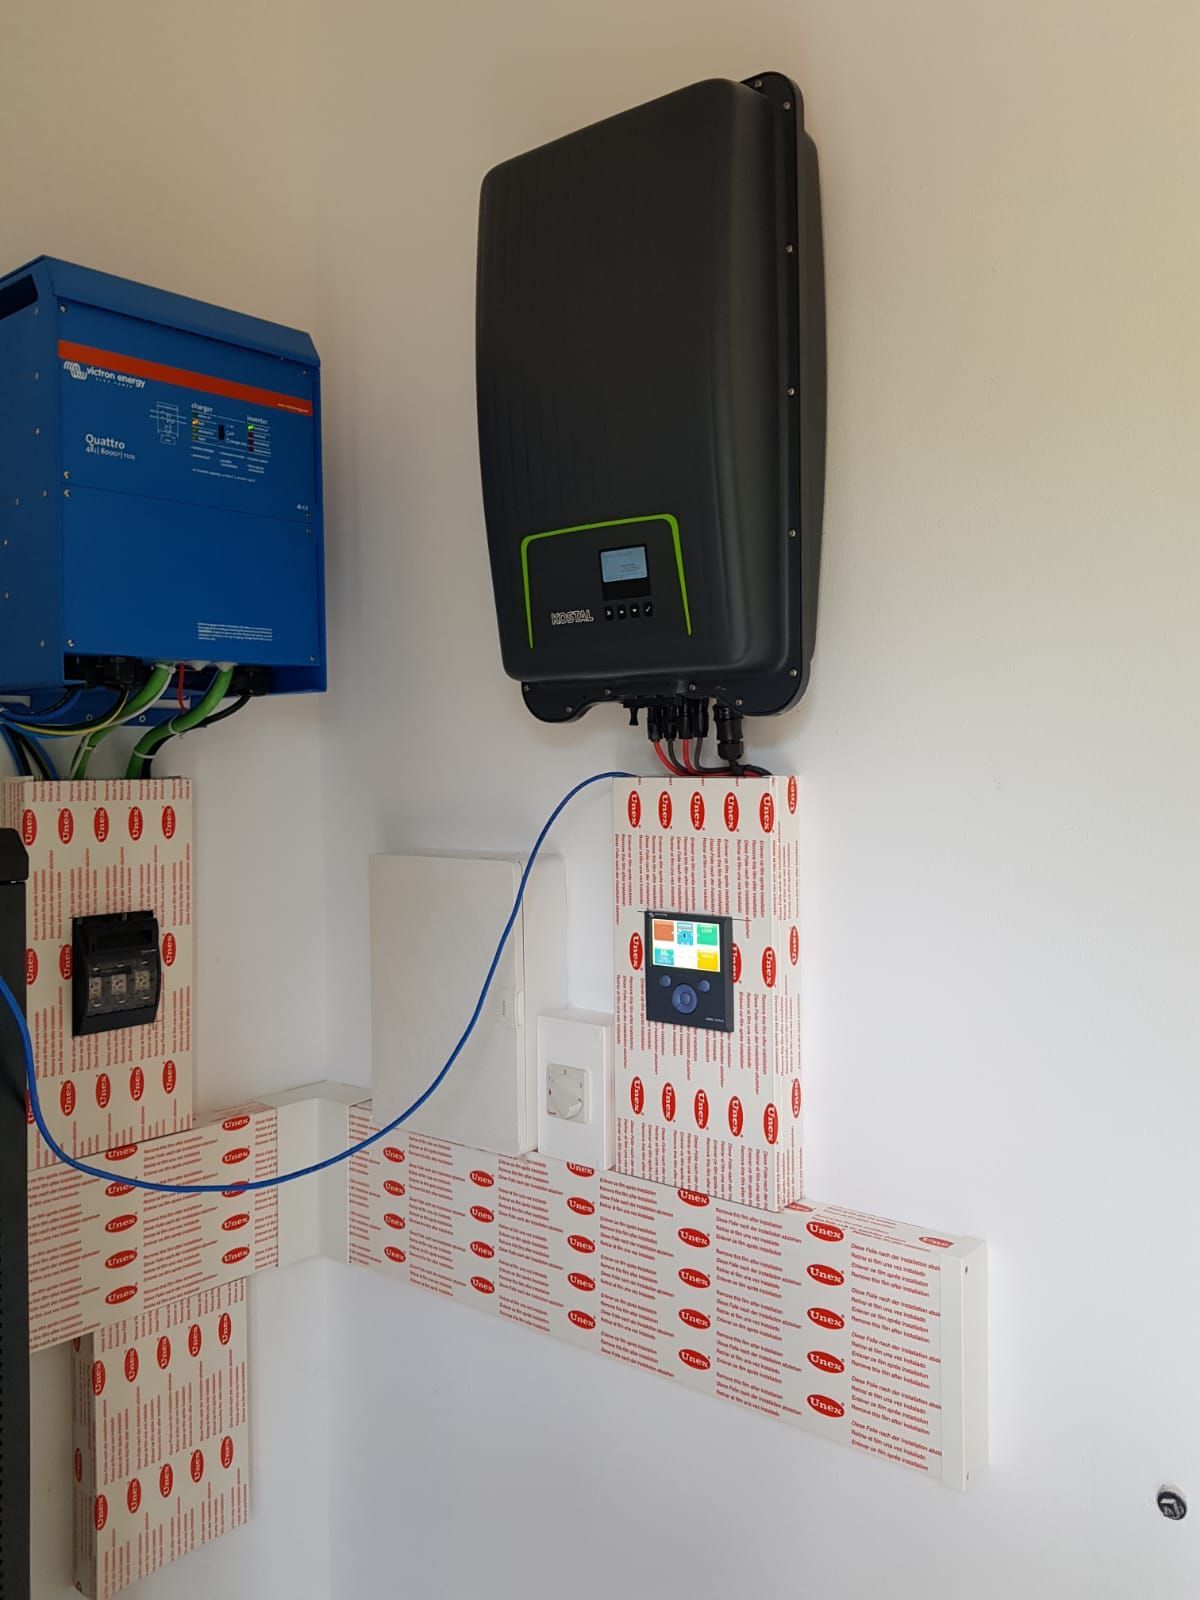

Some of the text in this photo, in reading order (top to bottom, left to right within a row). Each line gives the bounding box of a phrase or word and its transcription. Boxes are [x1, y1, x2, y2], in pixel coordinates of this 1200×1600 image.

[87, 366, 115, 380] victron
[117, 374, 146, 389] energy
[86, 433, 125, 449] Quattro
[551, 609, 594, 626] KOSTAL
[661, 794, 669, 827] Unex
[693, 794, 701, 829] Unex
[727, 795, 736, 830] Unex
[762, 796, 771, 831] Unex
[25, 811, 33, 843] Unex
[62, 810, 70, 842] Unex
[132, 808, 140, 840] Unex
[632, 935, 640, 969] Unex
[765, 950, 773, 986] Unex
[64, 1082, 72, 1114] Unex
[100, 1074, 108, 1106] Unex
[633, 1079, 641, 1113] Unex
[665, 1086, 673, 1119] Unex
[697, 1092, 705, 1127] Unex
[224, 1117, 249, 1129] Unex
[731, 1099, 740, 1134] Unex
[766, 1107, 775, 1142] Unex
[108, 1147, 135, 1159] Unex
[224, 1150, 249, 1162] Unex
[385, 1148, 403, 1160] Unex
[472, 1171, 493, 1185] Unex
[385, 1181, 403, 1195] Unex
[569, 1198, 594, 1213] Unex
[679, 1189, 708, 1205] Unex
[224, 1216, 249, 1229] Unex
[385, 1214, 404, 1227] Unex
[472, 1207, 492, 1221] Unex
[109, 1216, 136, 1230] Unex
[808, 1222, 842, 1240] Unex
[569, 1236, 594, 1251] Unex
[679, 1229, 709, 1245] Unex
[224, 1249, 248, 1262] Unex
[386, 1248, 404, 1261] Unex
[472, 1242, 493, 1257] Unex
[108, 1252, 136, 1266] Unex
[569, 1274, 594, 1289] Unex
[679, 1269, 709, 1286] Unex
[808, 1265, 843, 1283] Unex
[472, 1278, 492, 1292] Unex
[108, 1288, 136, 1302] Unex
[569, 1311, 594, 1327] Unex
[680, 1310, 708, 1327] Unex
[809, 1309, 843, 1327] Unex
[160, 1338, 168, 1367] Unex
[681, 1351, 709, 1368] Unex
[809, 1352, 843, 1371] Unex
[94, 1362, 102, 1393] Unex
[809, 1396, 843, 1415] Unex
[96, 1495, 105, 1529] Unex
